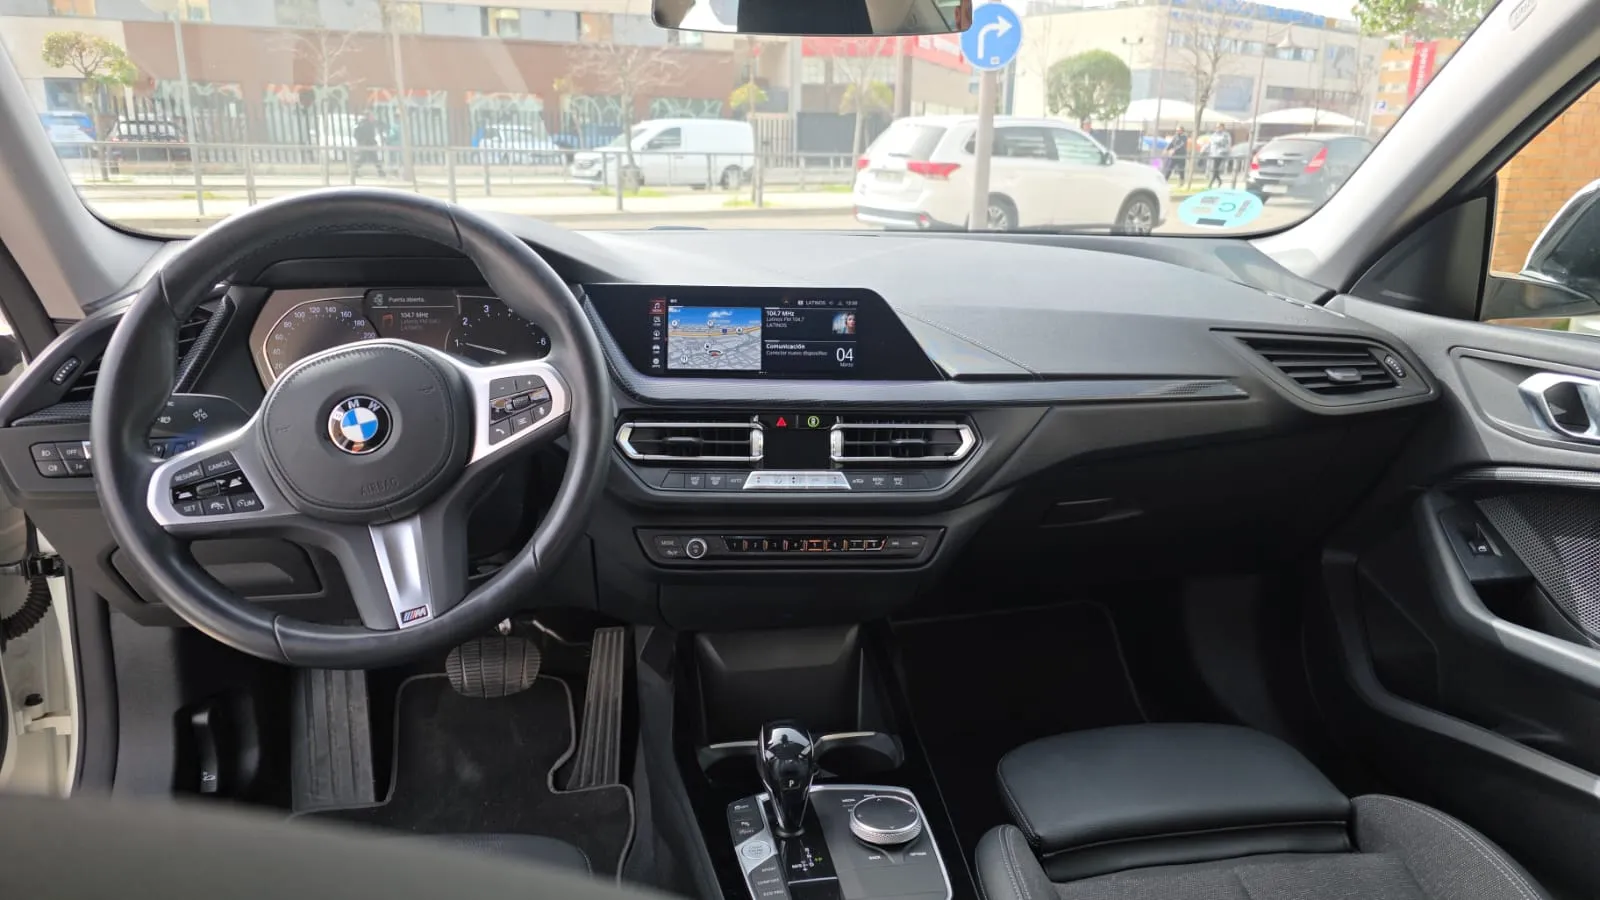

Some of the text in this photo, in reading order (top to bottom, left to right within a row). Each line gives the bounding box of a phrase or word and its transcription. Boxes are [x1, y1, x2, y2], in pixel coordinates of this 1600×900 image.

[483, 304, 490, 313] 3
[462, 317, 468, 326] 2
[454, 339, 459, 348] 1
[540, 338, 546, 346] 6
[836, 347, 854, 362] 04
[332, 399, 381, 421] BMW
[208, 460, 233, 471] CANCEL
[175, 469, 200, 481] RESUME
[361, 477, 400, 497] AIRBAG
[183, 504, 197, 512] SET
